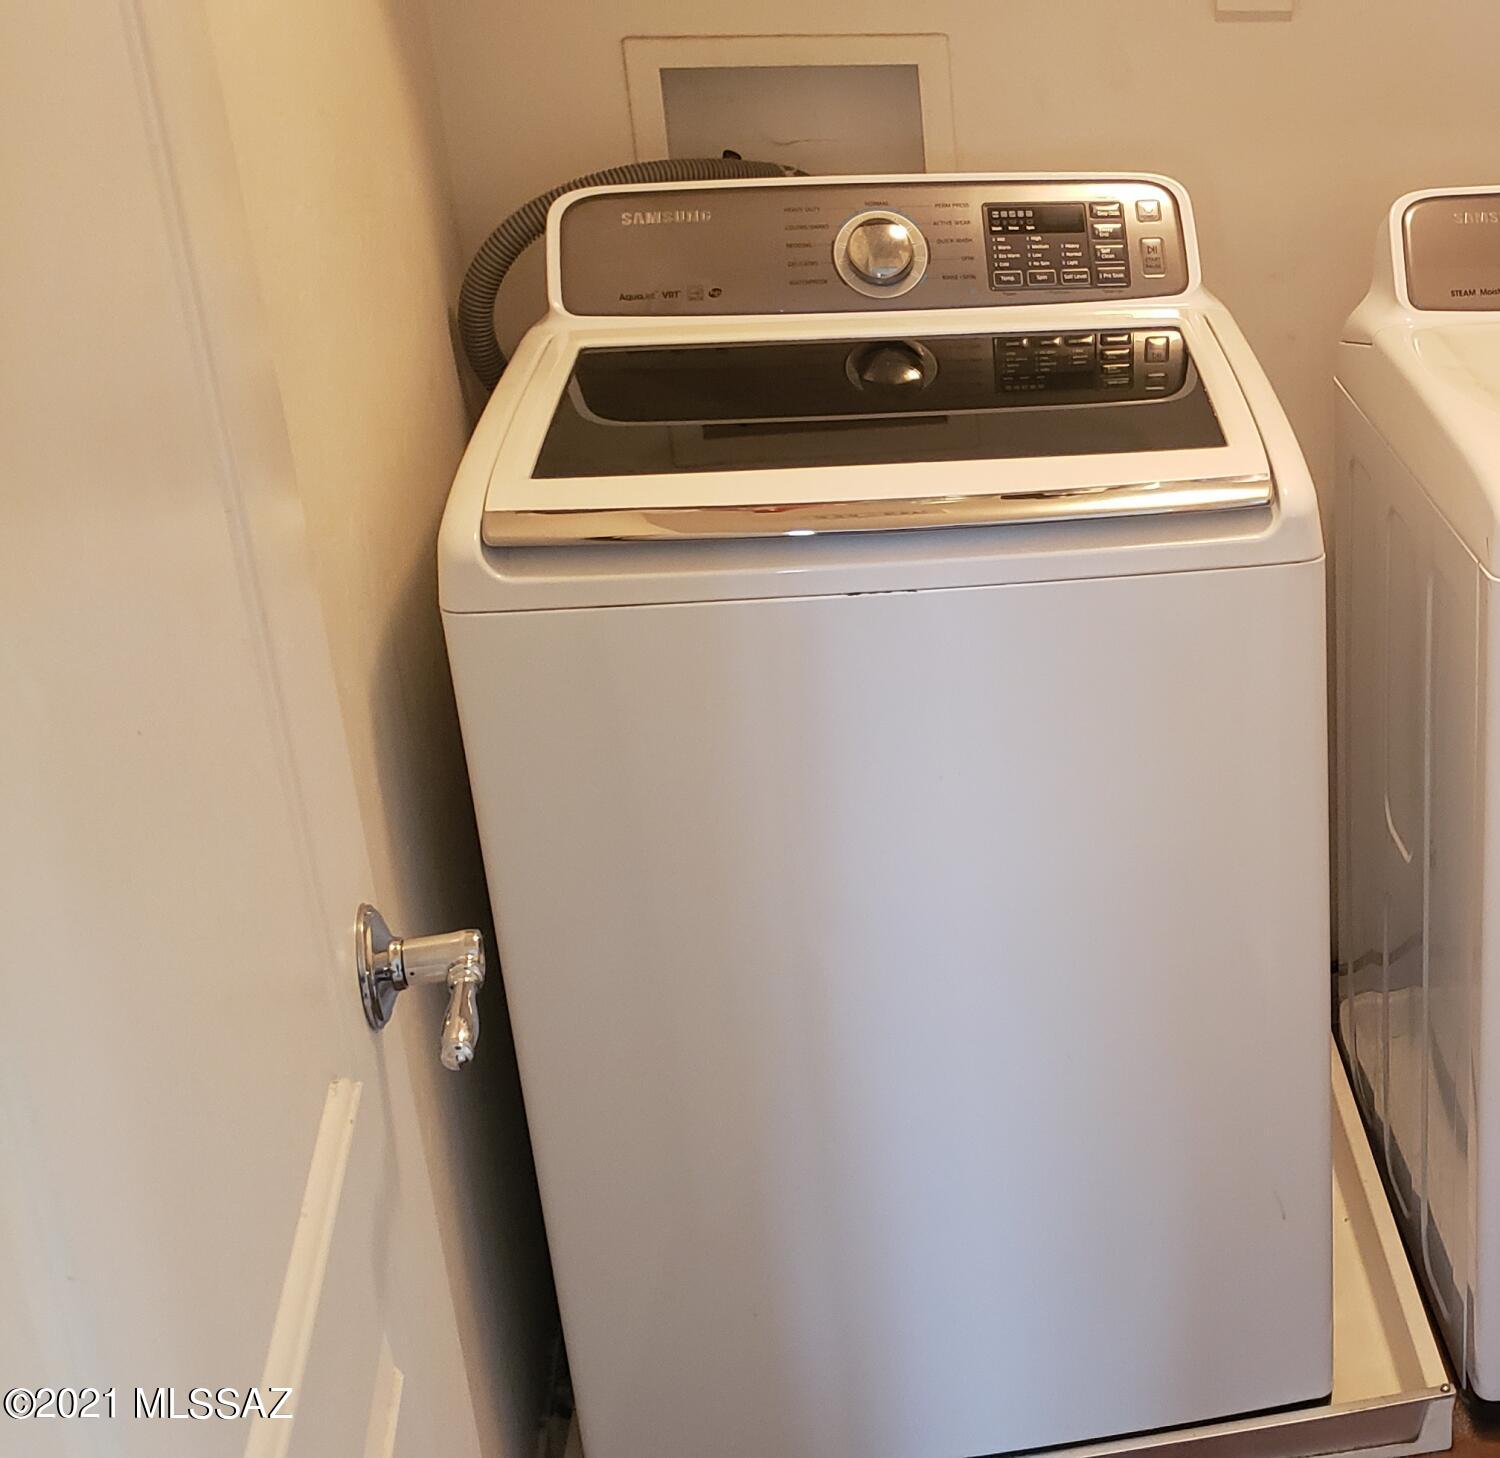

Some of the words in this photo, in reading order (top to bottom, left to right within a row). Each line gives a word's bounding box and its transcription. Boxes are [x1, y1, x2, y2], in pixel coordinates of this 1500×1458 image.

[621, 209, 712, 226] SAMSUNG
[661, 290, 681, 300] VRT
[1450, 289, 1477, 298] STEAM
